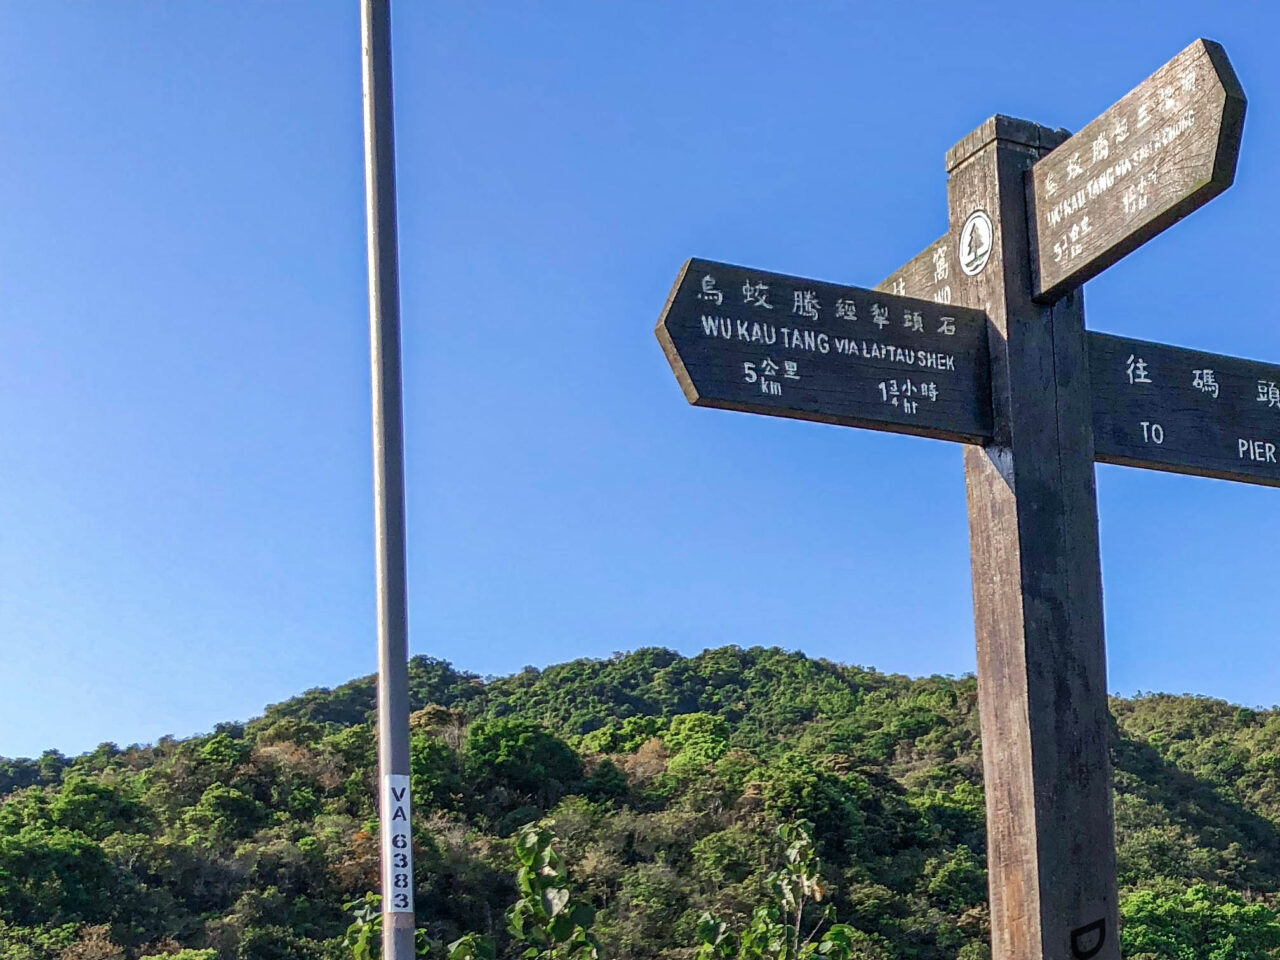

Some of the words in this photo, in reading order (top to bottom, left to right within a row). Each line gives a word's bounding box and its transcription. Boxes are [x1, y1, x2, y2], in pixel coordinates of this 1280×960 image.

[1064, 191, 1086, 218] KAU
[1086, 166, 1115, 199] TANG
[701, 314, 732, 339] WU
[737, 319, 776, 344] KAU
[781, 327, 830, 353] TANG
[835, 338, 860, 356] VIA
[887, 345, 915, 365] TAU
[918, 351, 955, 371] SHEK
[744, 361, 757, 383] 5
[761, 357, 800, 379] 公里
[761, 377, 782, 396] km
[901, 378, 939, 402] 小時
[904, 399, 919, 414] hr
[1140, 421, 1165, 444] TO
[1238, 438, 1277, 463] PIER
